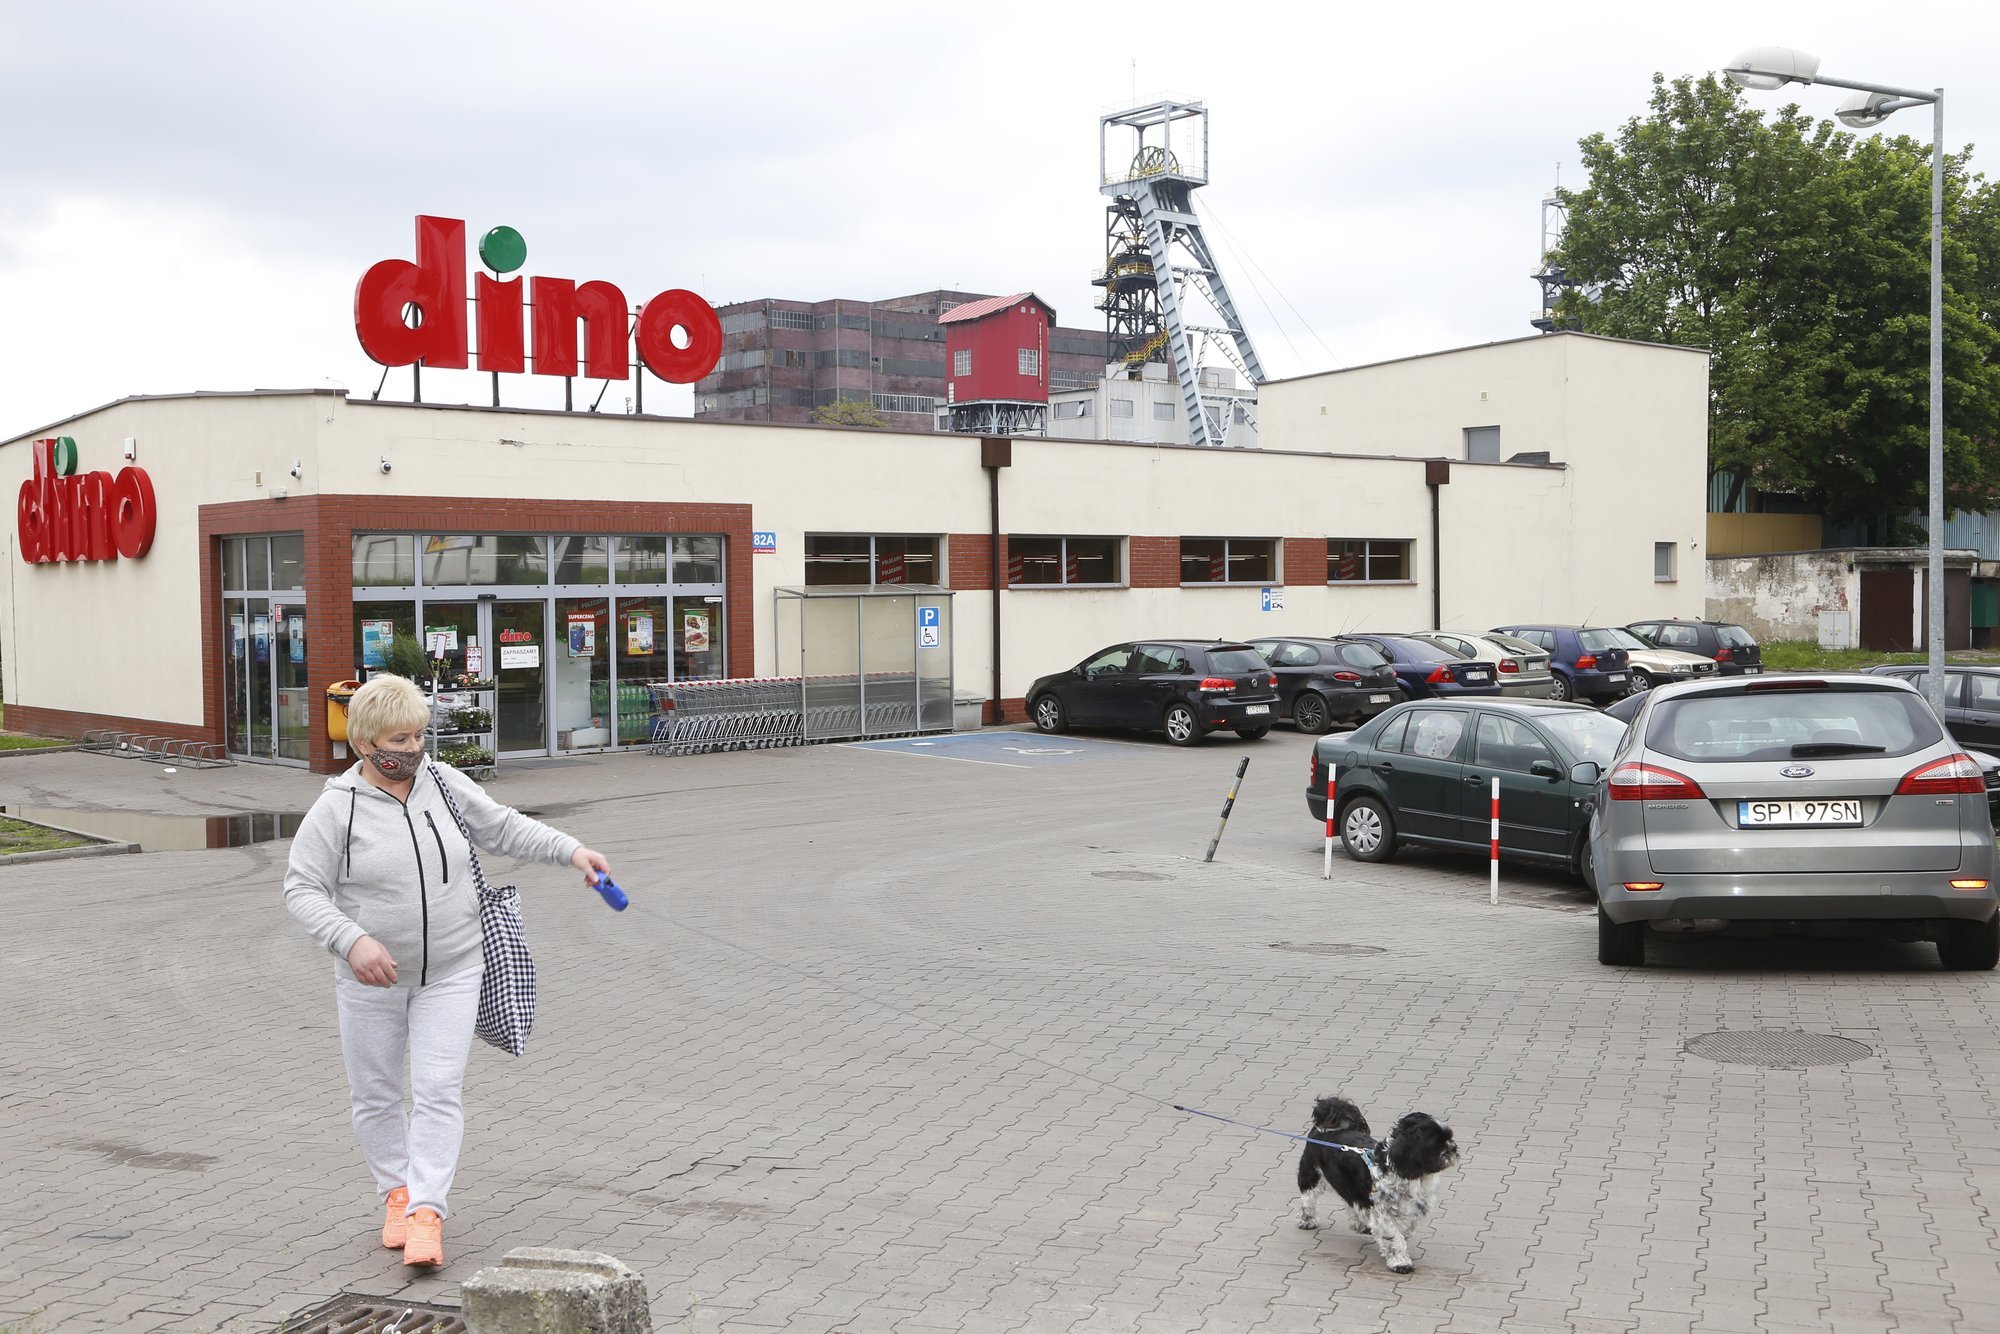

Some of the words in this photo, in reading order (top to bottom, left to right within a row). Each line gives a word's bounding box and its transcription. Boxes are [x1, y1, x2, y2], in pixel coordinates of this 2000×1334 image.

[354, 215, 722, 384] dino
[18, 436, 156, 564] dino
[753, 534, 775, 546] 82A
[1263, 593, 1270, 607] P
[925, 609, 935, 625] P
[500, 628, 532, 642] dino
[1787, 766, 1807, 776] Ford
[1752, 803, 1793, 822] SPI
[1804, 802, 1858, 821] 97SN
